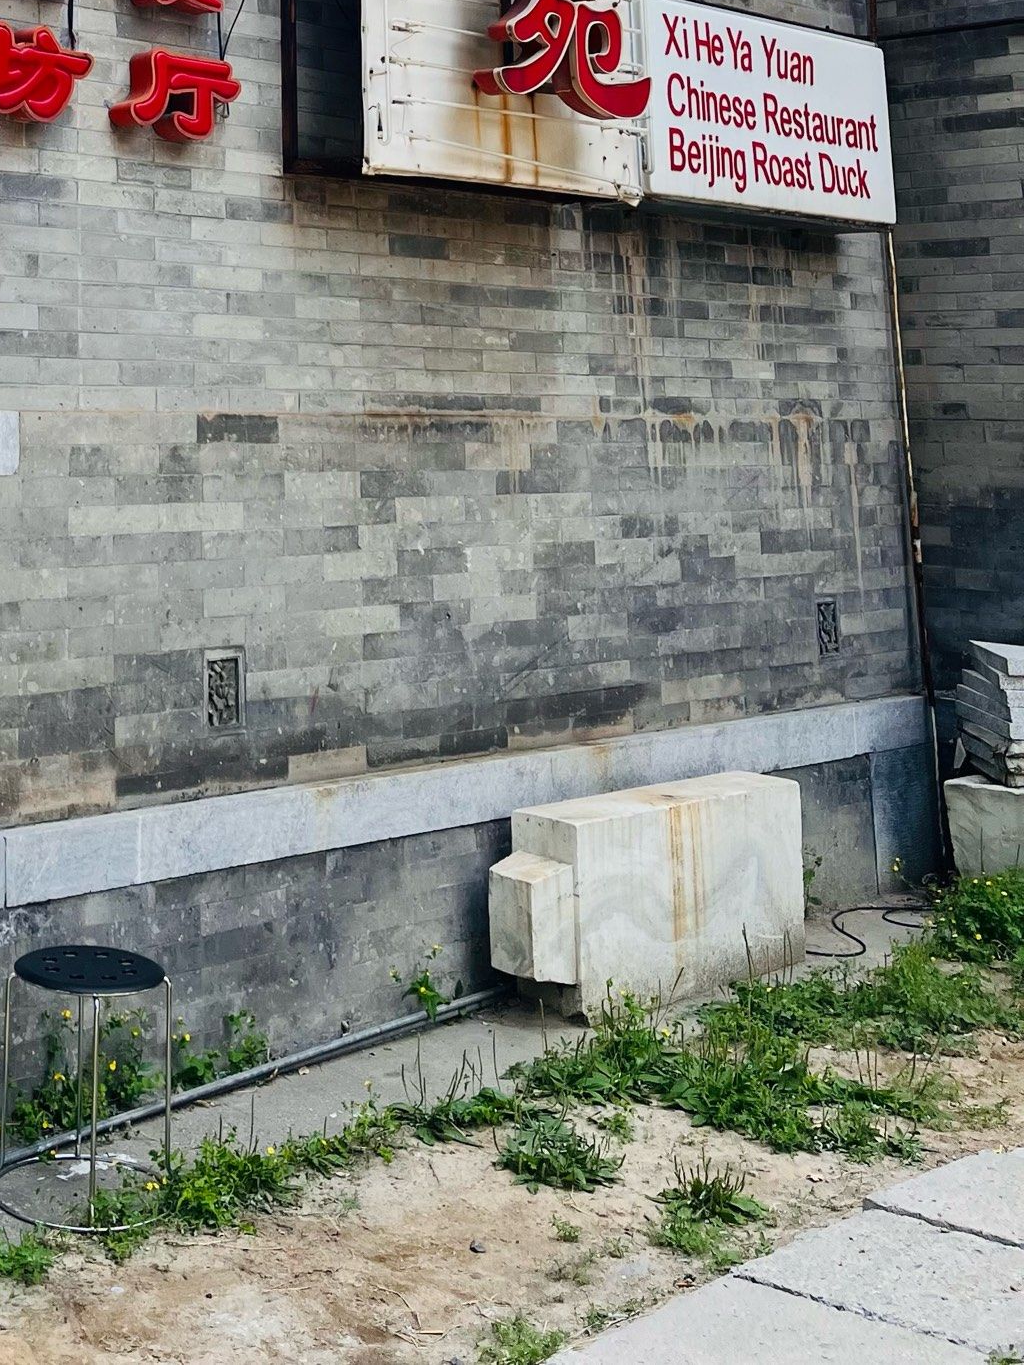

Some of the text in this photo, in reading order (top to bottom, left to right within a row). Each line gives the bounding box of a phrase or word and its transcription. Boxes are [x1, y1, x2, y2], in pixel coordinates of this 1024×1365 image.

[662, 12, 814, 85] Xi He Ya Yuan
[667, 73, 879, 152] Chinese Restaurant
[668, 127, 871, 199] Beijing Roast Duck
